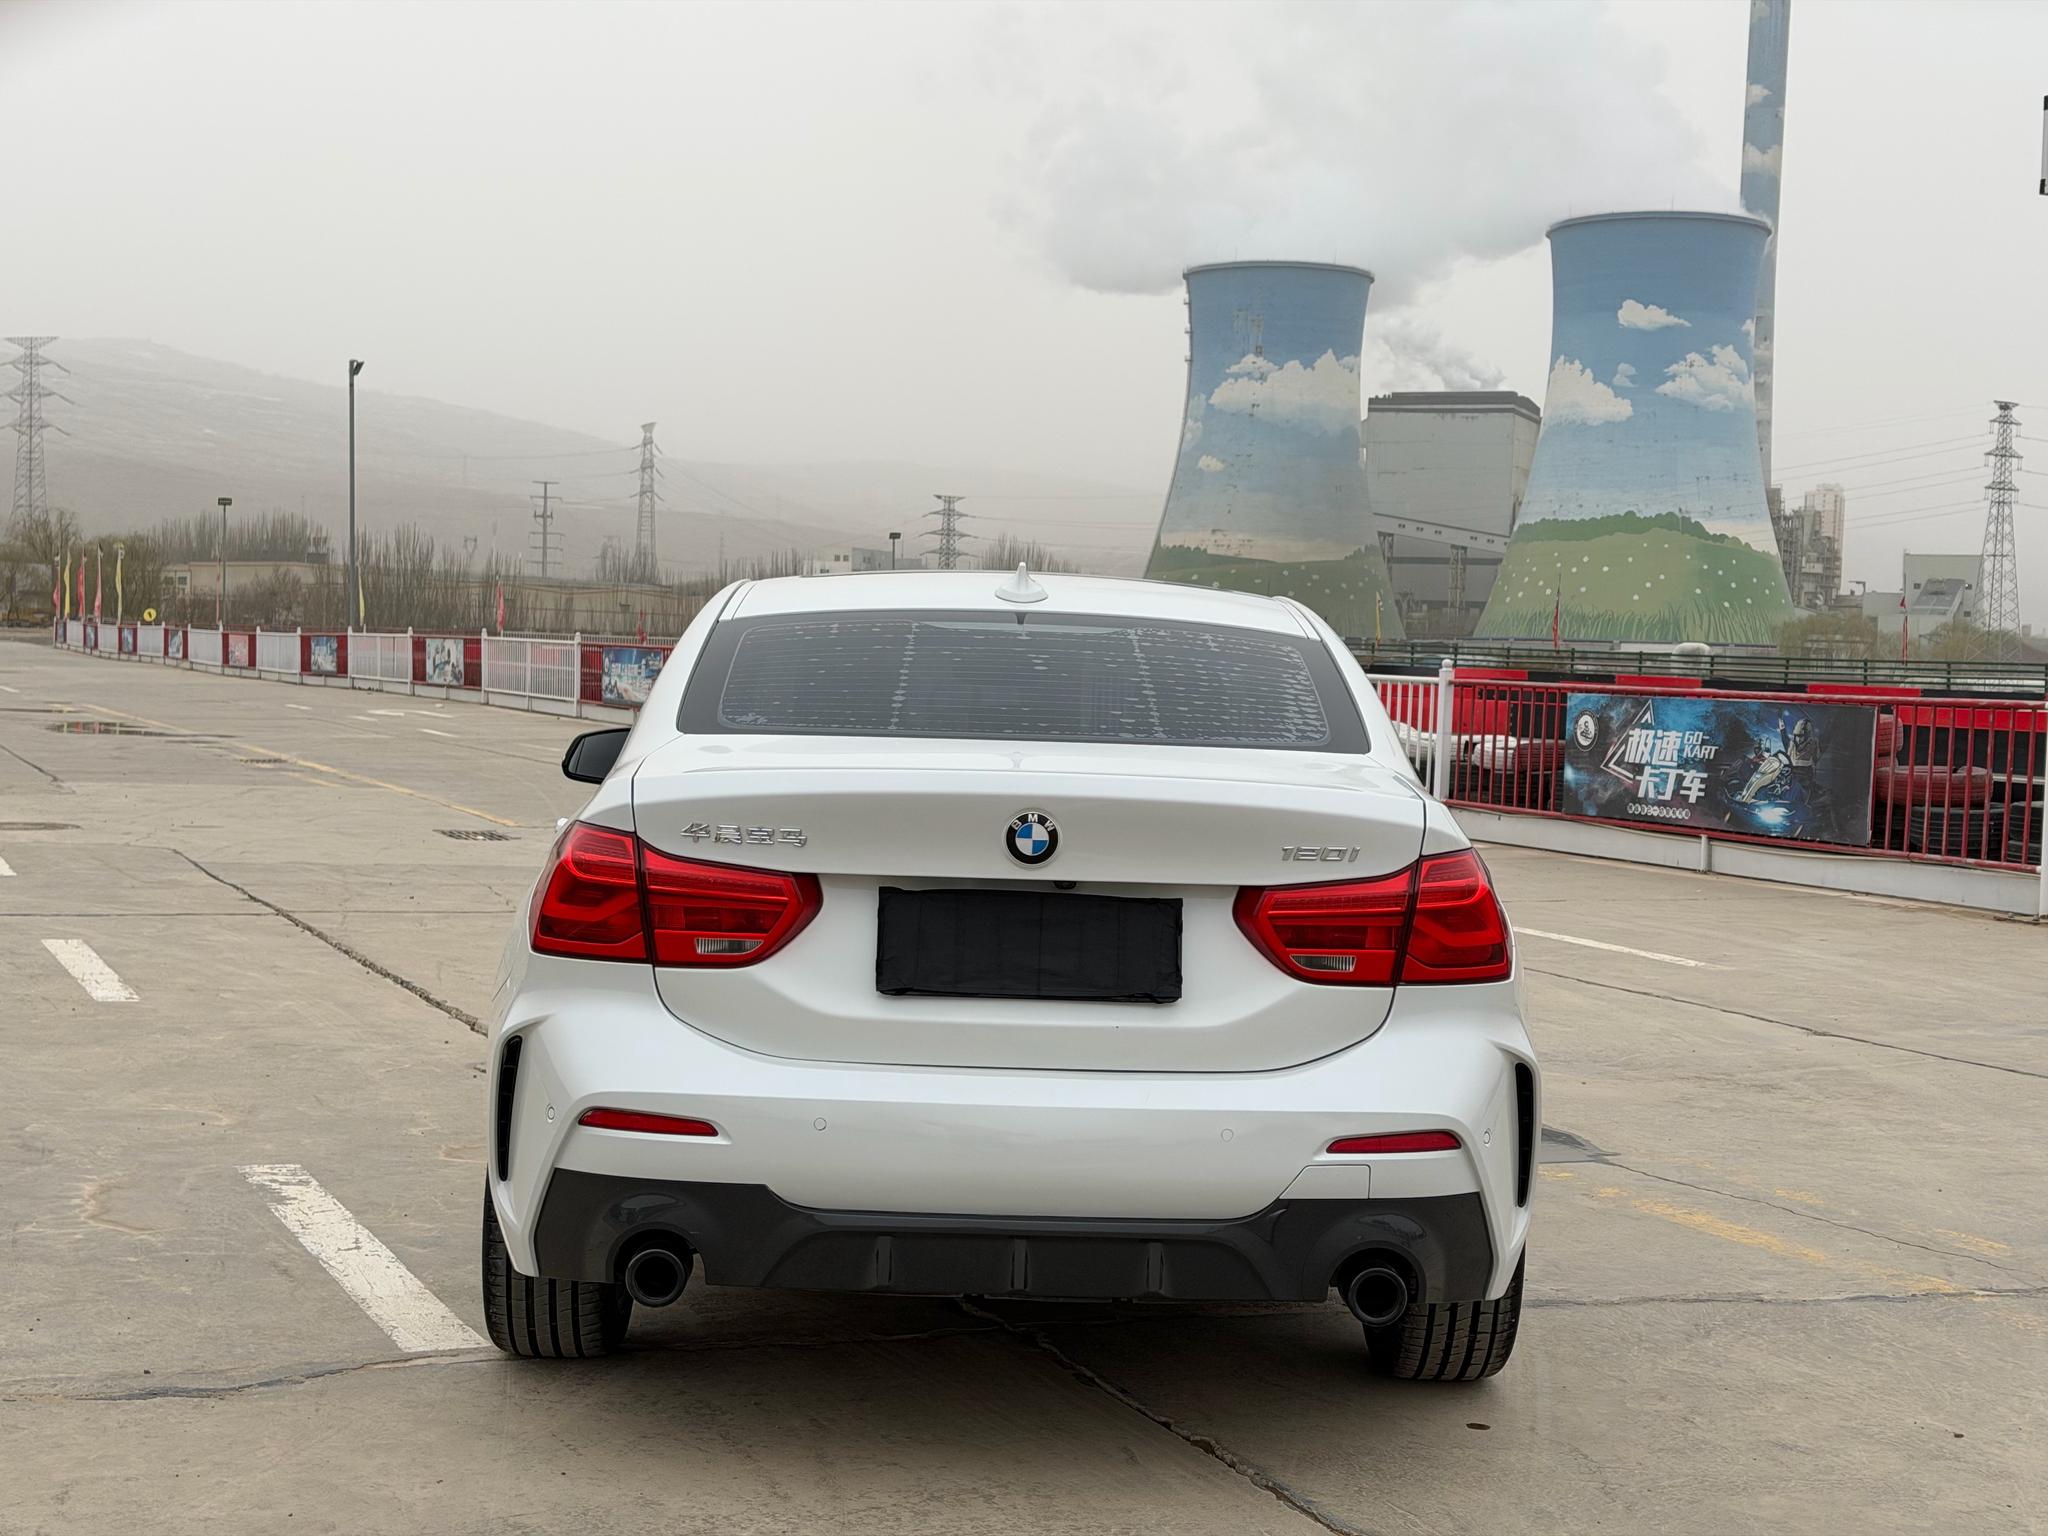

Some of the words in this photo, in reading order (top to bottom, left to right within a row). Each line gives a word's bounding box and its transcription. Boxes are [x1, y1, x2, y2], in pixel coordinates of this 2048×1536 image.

[1624, 728, 1682, 767] 极速
[1683, 744, 1719, 760] KART
[1635, 765, 1708, 803] 卡丁车
[680, 822, 808, 847] 华晨宝马
[1011, 813, 1055, 832] BMW
